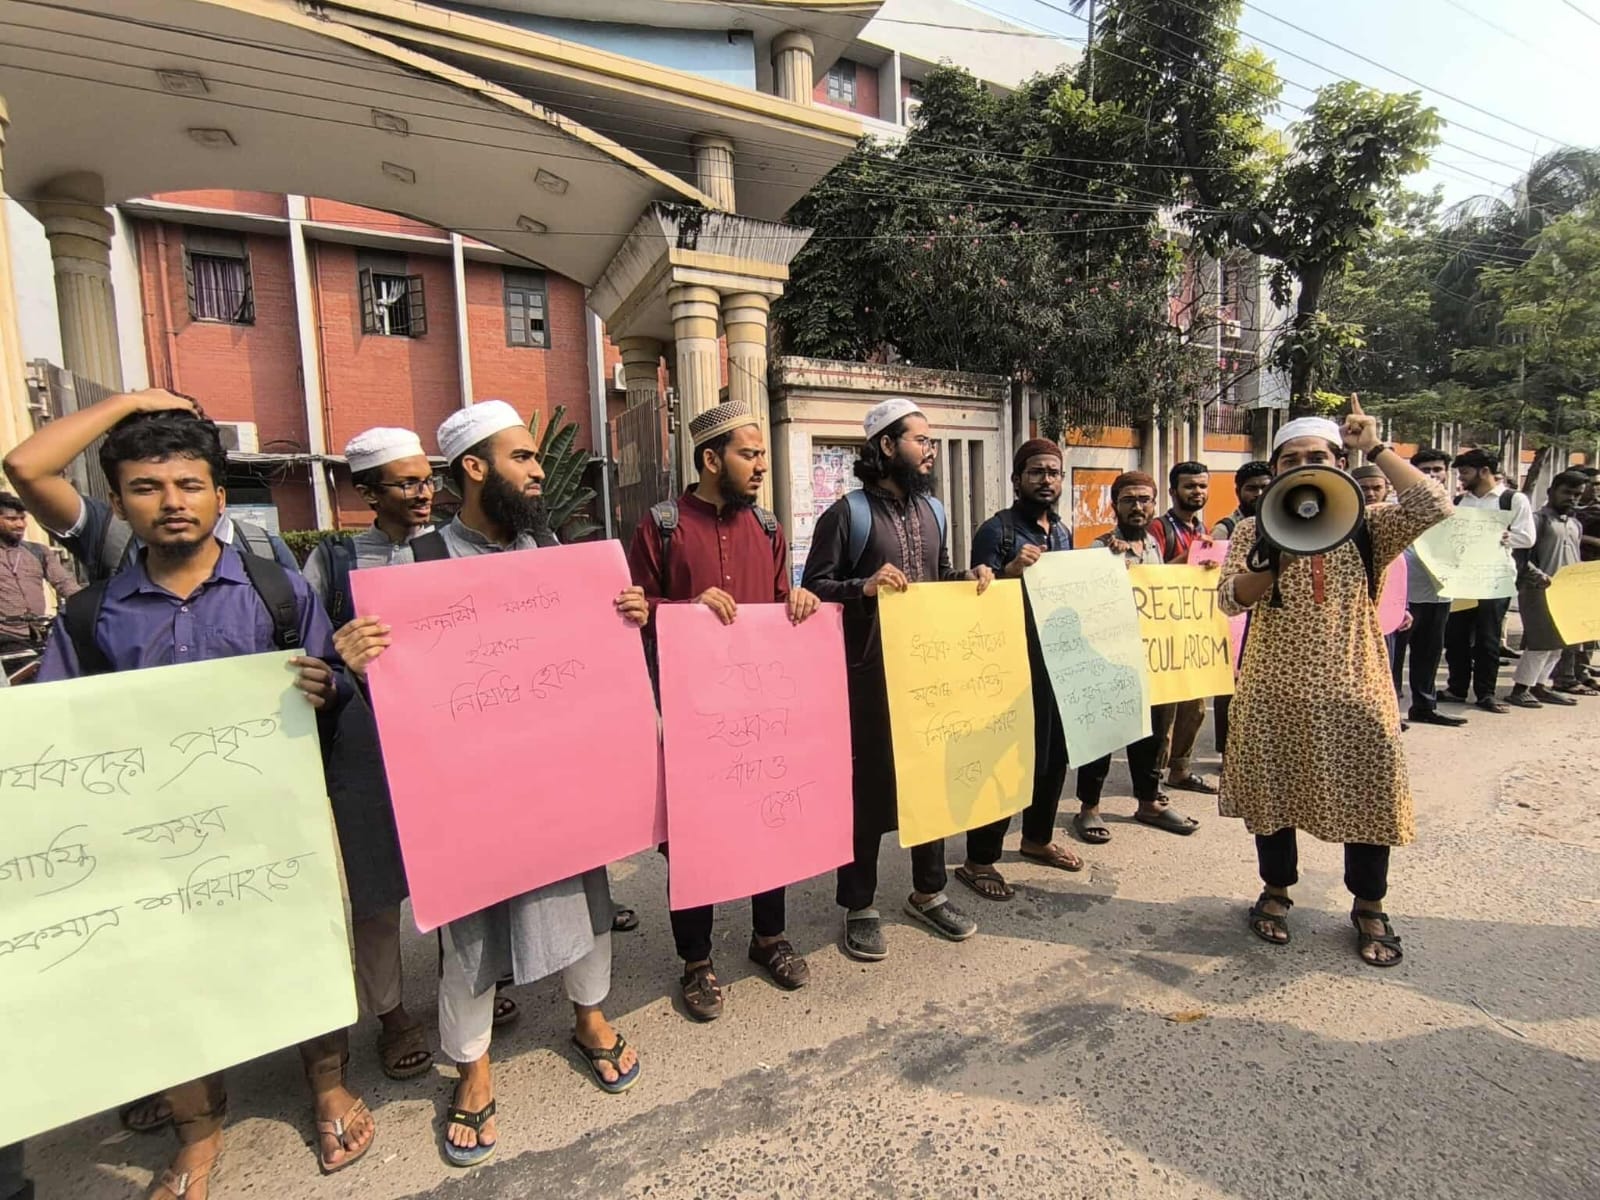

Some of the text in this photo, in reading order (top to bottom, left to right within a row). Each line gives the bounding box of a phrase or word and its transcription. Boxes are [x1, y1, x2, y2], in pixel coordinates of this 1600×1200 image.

[1131, 585, 1219, 621] REJECT
[1142, 633, 1230, 673] CULARISM
[0, 711, 282, 795] র্ষকদের প্রকৃত
